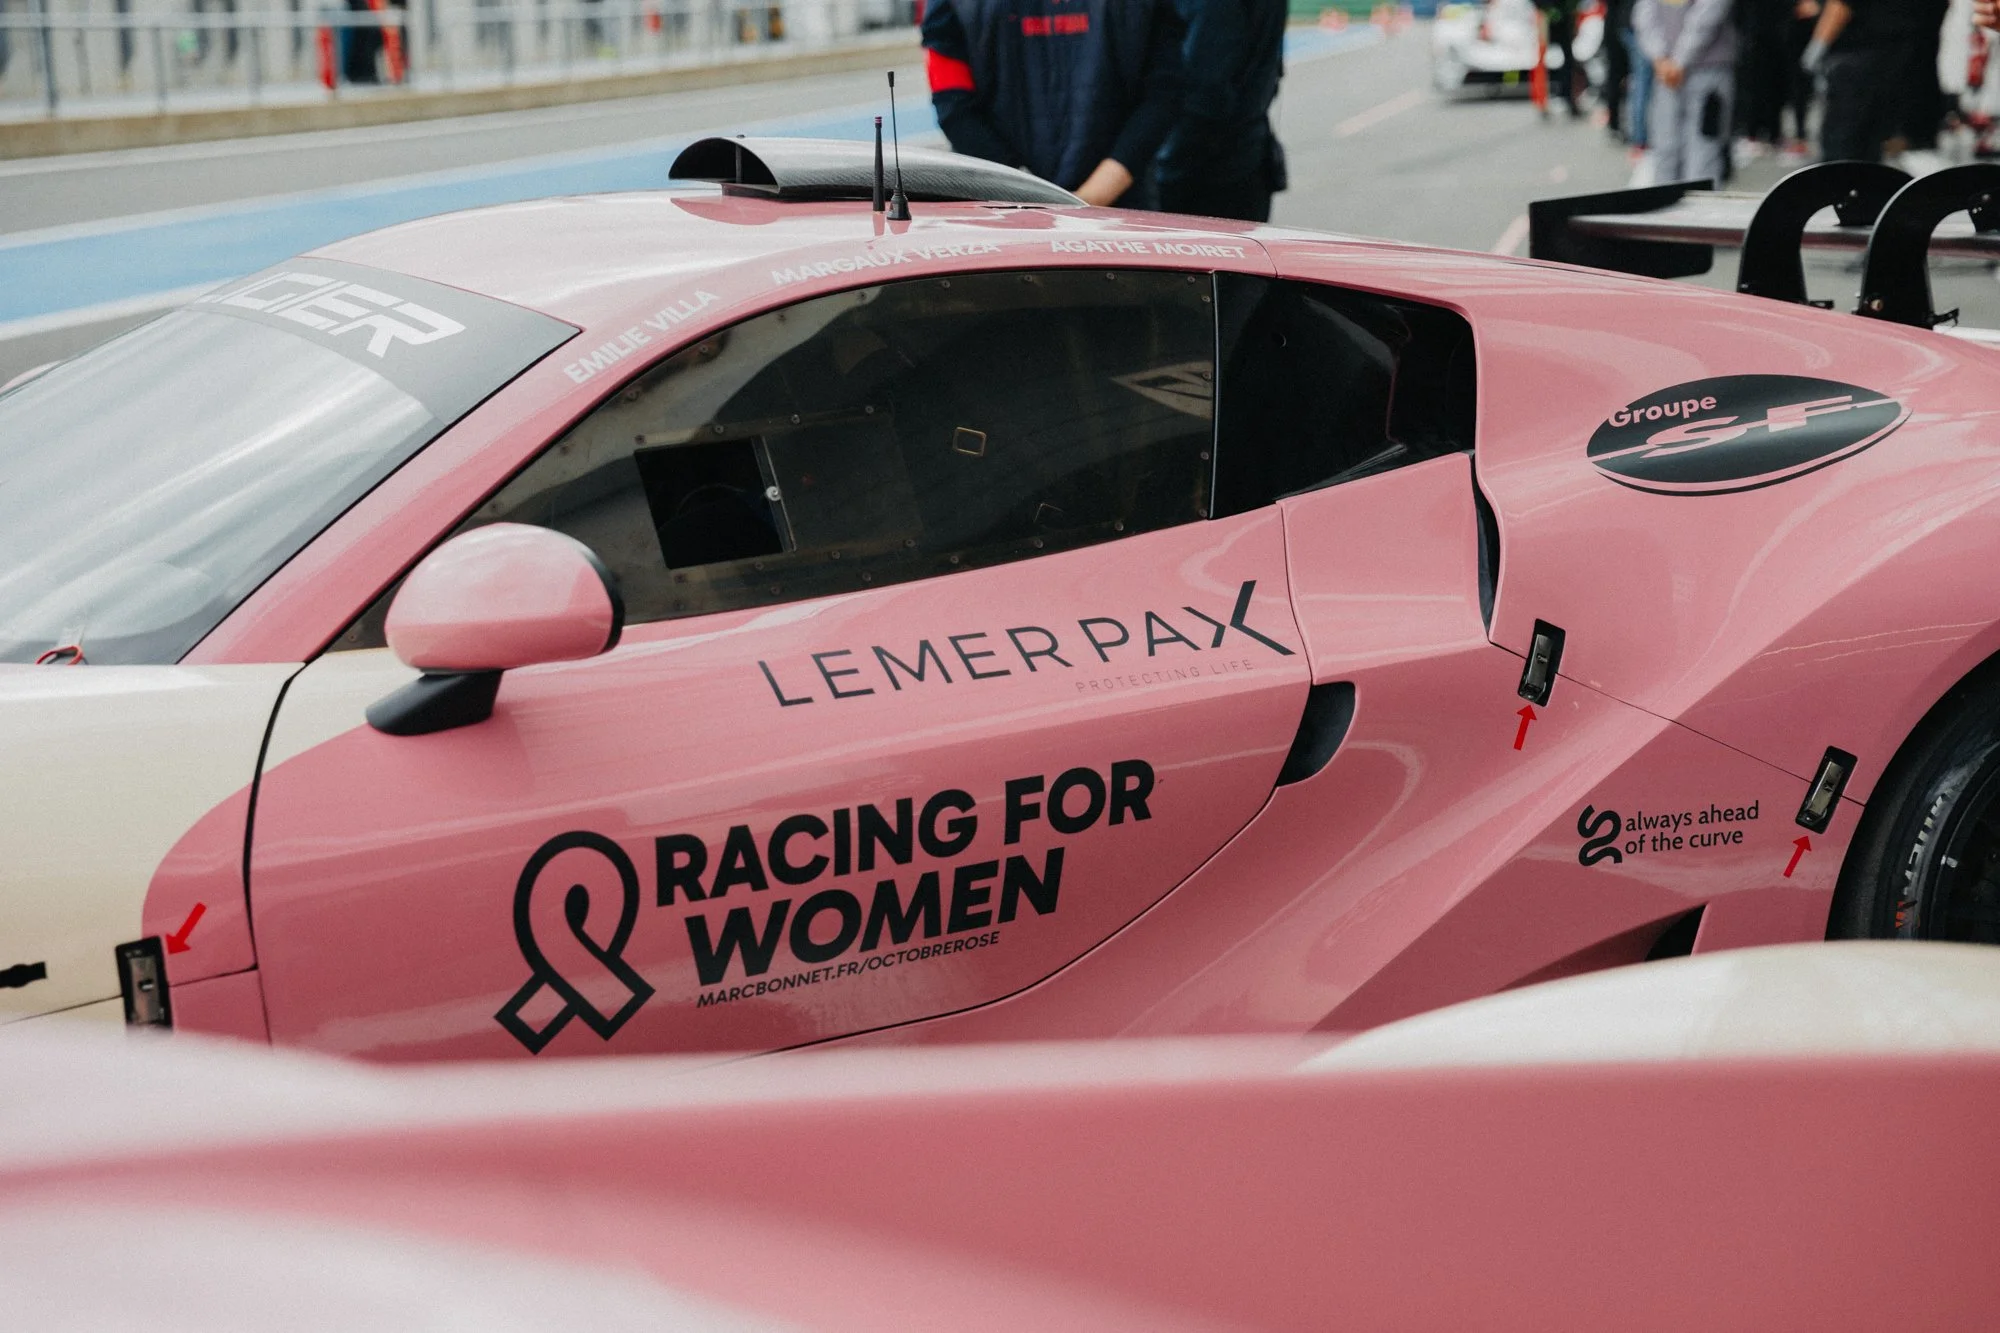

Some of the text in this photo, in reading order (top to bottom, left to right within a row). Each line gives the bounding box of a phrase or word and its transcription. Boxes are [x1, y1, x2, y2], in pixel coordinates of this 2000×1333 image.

[771, 243, 1003, 285] MARGAUX VERZA
[1050, 239, 1246, 259] AGATHE MOIRET
[563, 290, 721, 384] EMILIE VILLA
[1608, 396, 1717, 428] Groupe
[757, 579, 1296, 707] LEMER PAX
[1075, 659, 1254, 693] PROTECTING LIFE
[654, 758, 1155, 908] RACING FOR
[1625, 799, 1760, 833] always ahead
[1625, 830, 1743, 855] of the curve
[684, 846, 1065, 987] WOMEN
[696, 931, 1000, 1008] MARCBONNET.FR/OCTOBREROSE
